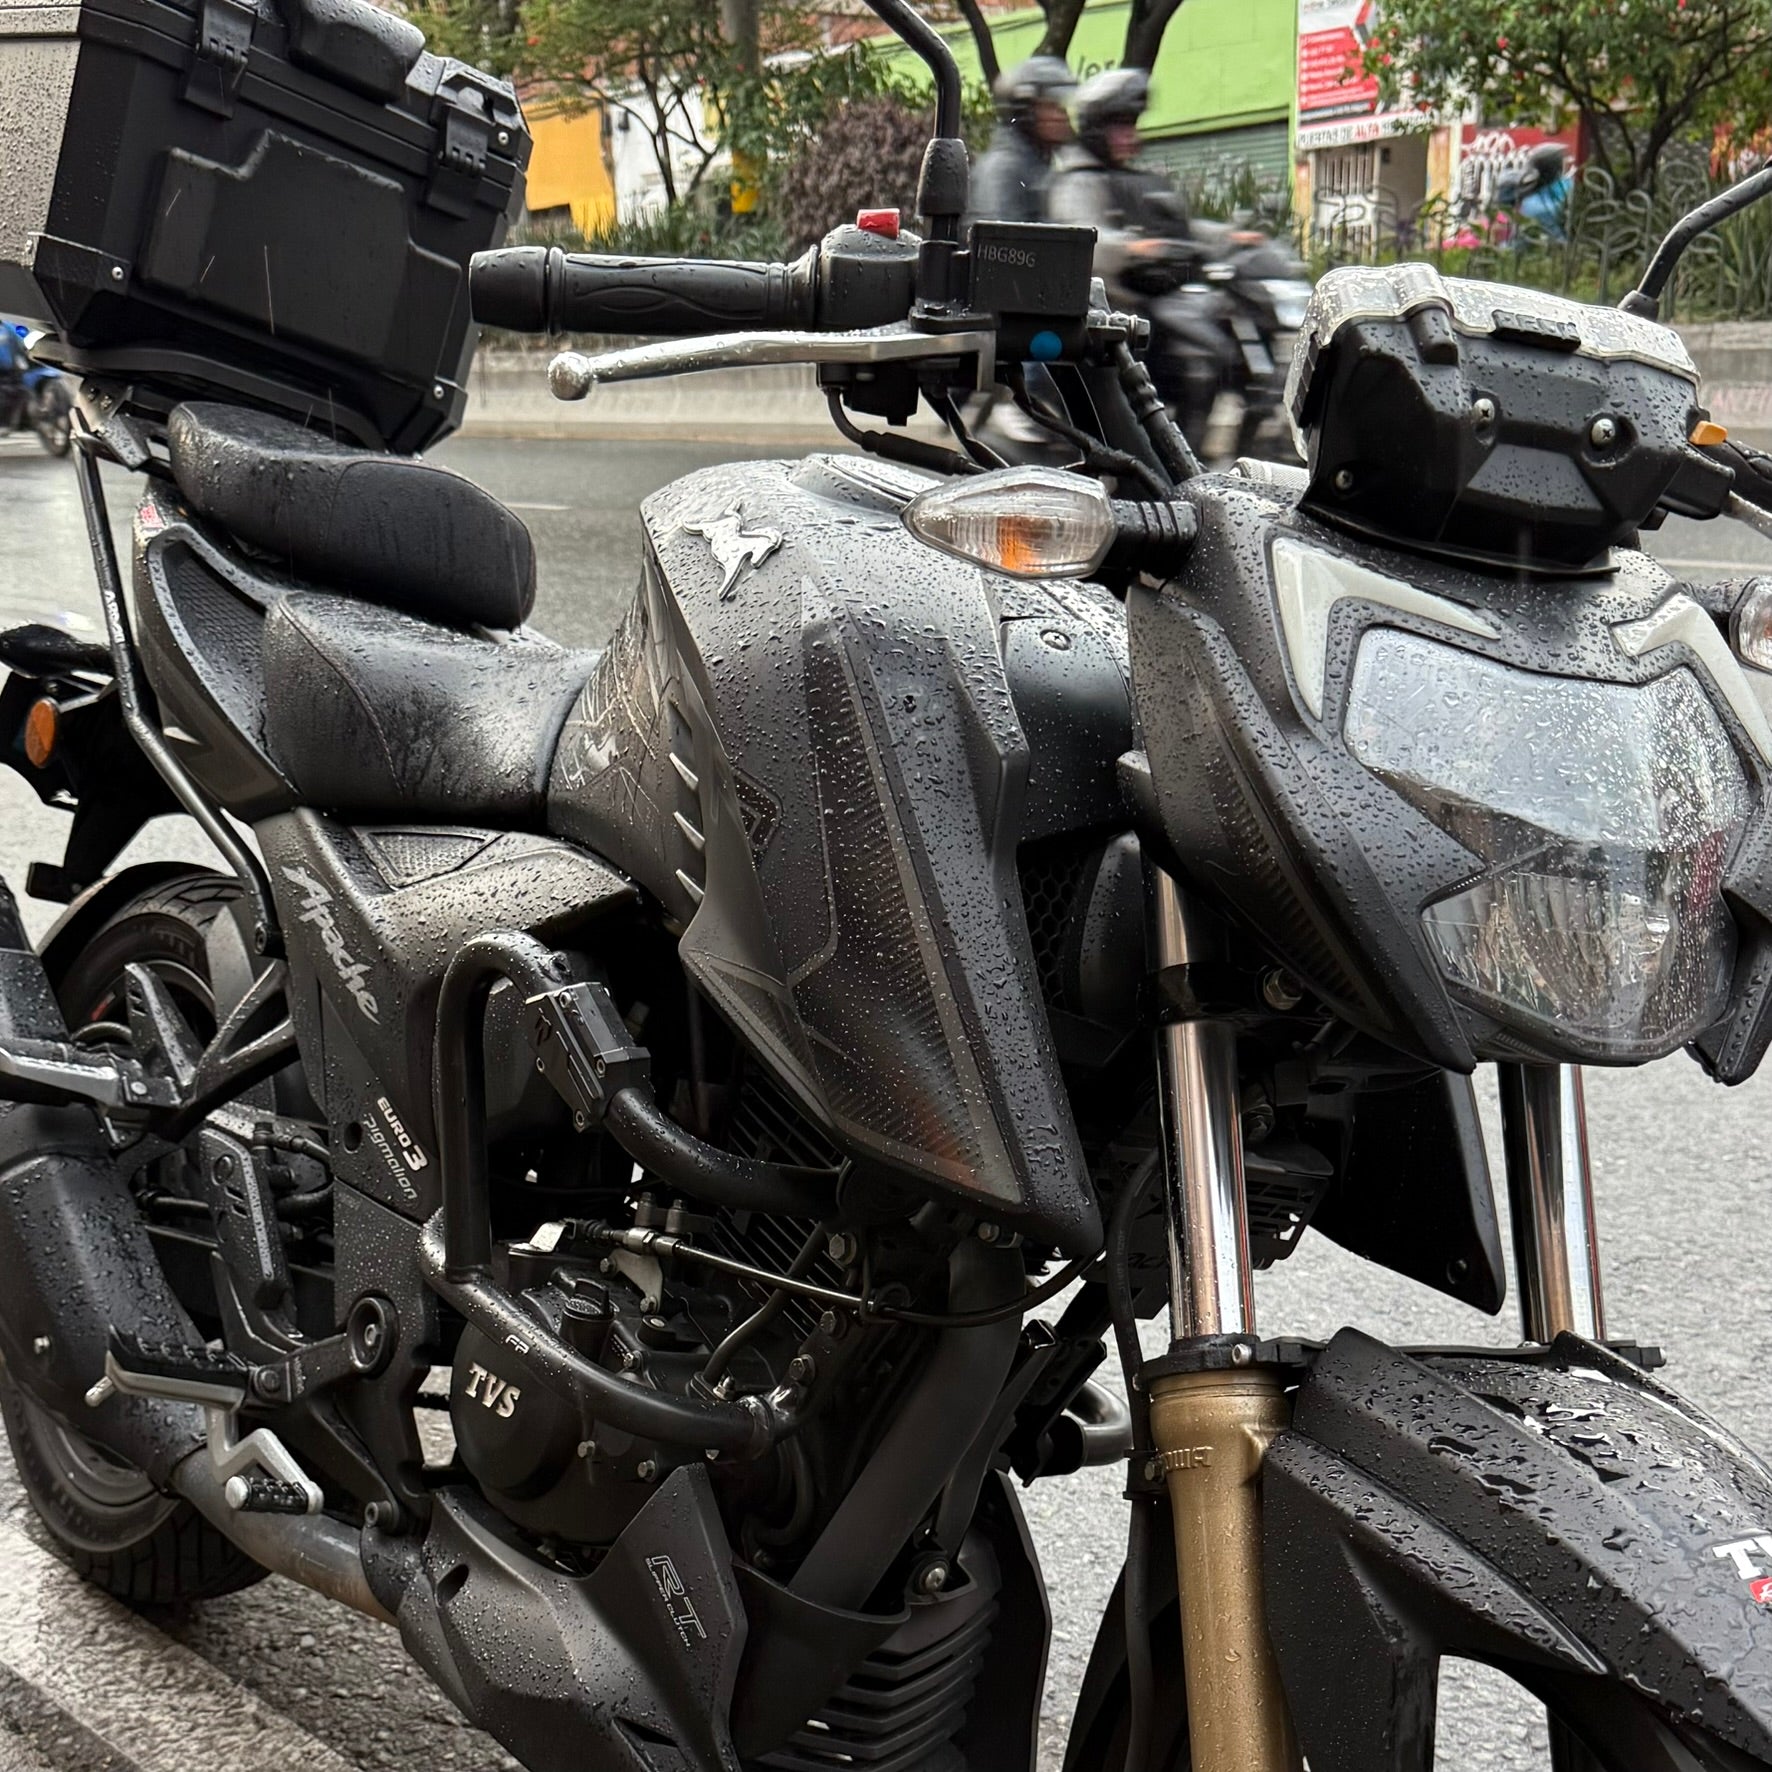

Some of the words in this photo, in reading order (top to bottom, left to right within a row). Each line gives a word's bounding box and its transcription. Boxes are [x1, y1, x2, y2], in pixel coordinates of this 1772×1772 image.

[977, 243, 1036, 268] HBG89G
[280, 866, 380, 1025] Apache
[465, 1361, 521, 1418] TVS
[651, 1555, 707, 1639] RT
